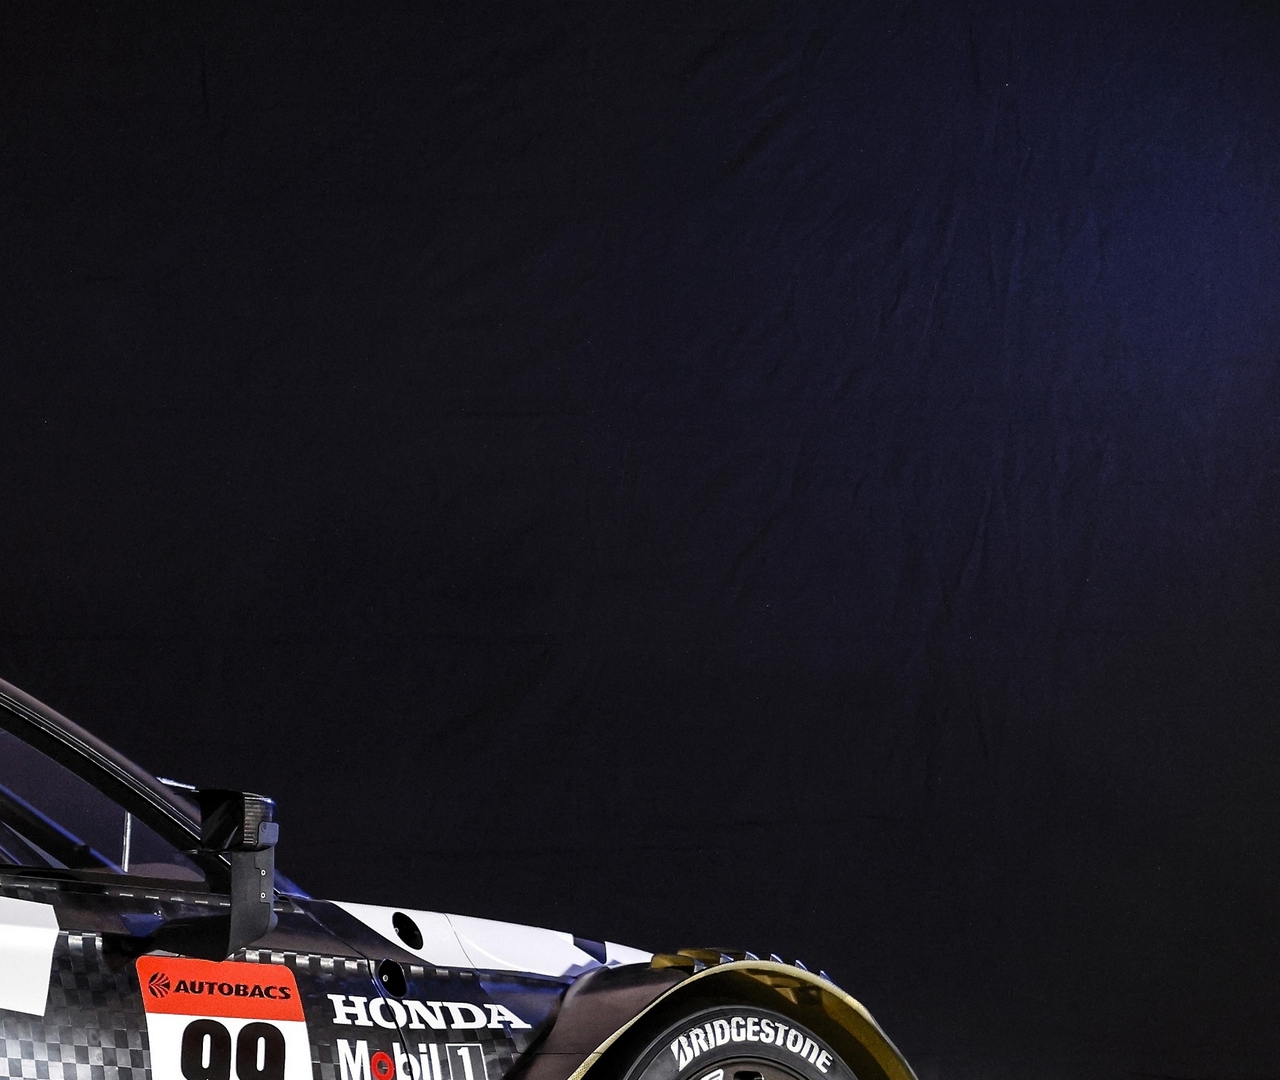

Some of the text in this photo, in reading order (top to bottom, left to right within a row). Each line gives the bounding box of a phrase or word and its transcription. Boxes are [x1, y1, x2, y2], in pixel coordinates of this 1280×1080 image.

[173, 979, 292, 1001] AUTOBACS
[327, 993, 532, 1030] HONDA
[670, 1016, 833, 1073] BRIDGESTONE
